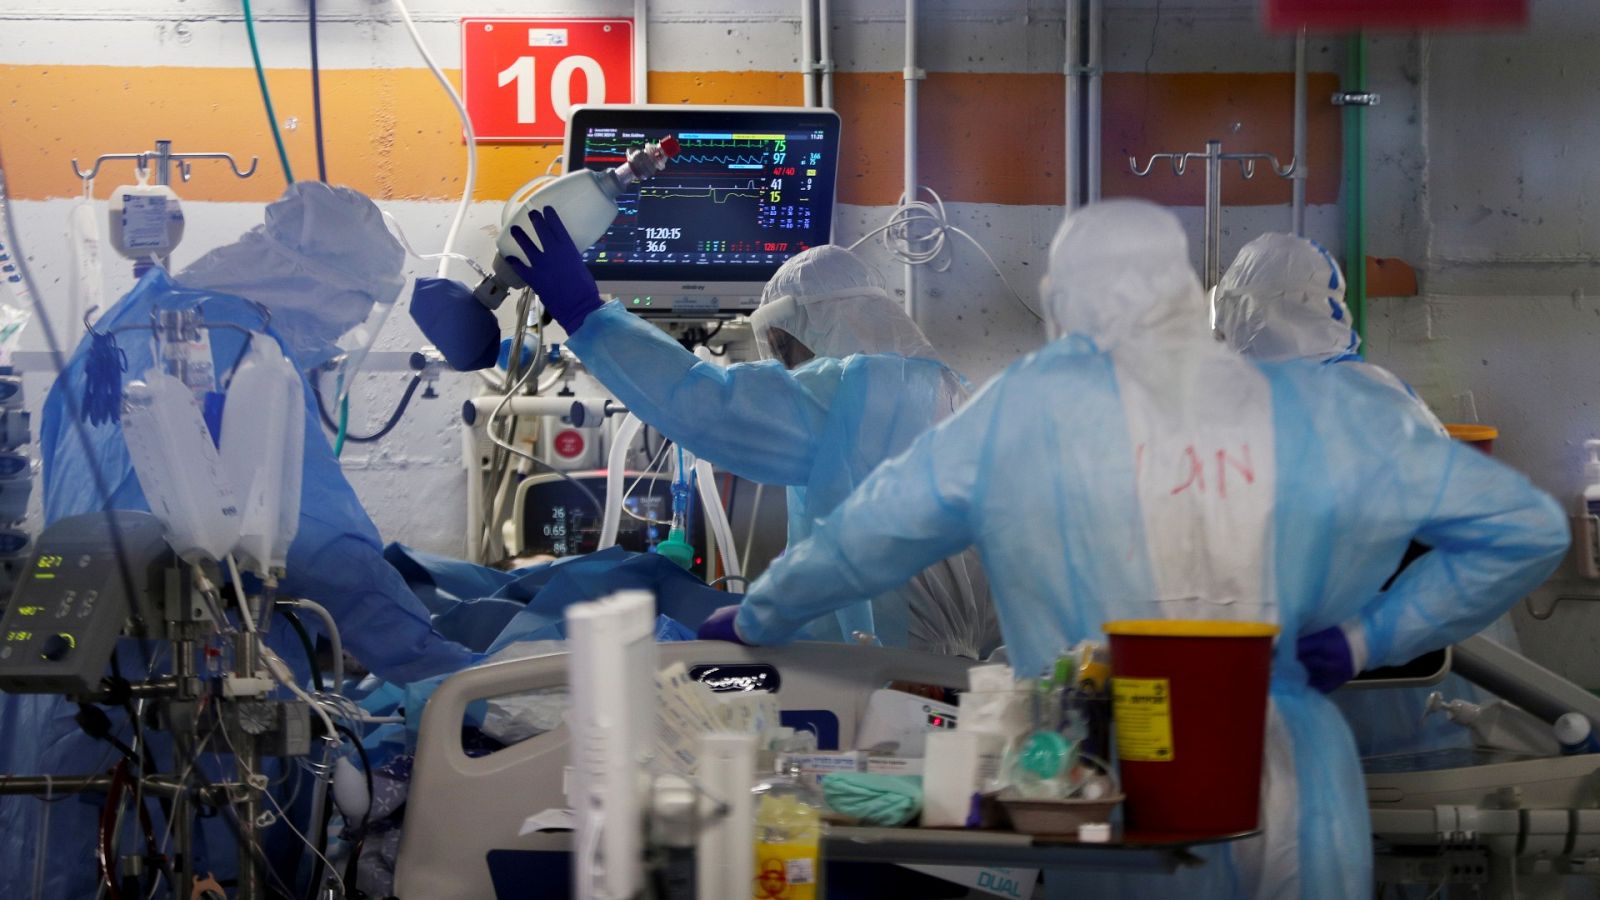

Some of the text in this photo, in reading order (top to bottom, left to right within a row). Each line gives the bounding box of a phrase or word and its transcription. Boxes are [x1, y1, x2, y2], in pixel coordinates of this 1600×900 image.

[498, 55, 606, 123] 10
[775, 140, 786, 151] 75
[773, 153, 786, 164] 97
[770, 179, 782, 190] 41
[771, 191, 781, 202] 15
[645, 228, 681, 239] 11:20:15
[645, 241, 667, 252] 36.6
[543, 525, 566, 536] 0.65
[977, 871, 1022, 897] DUAL
